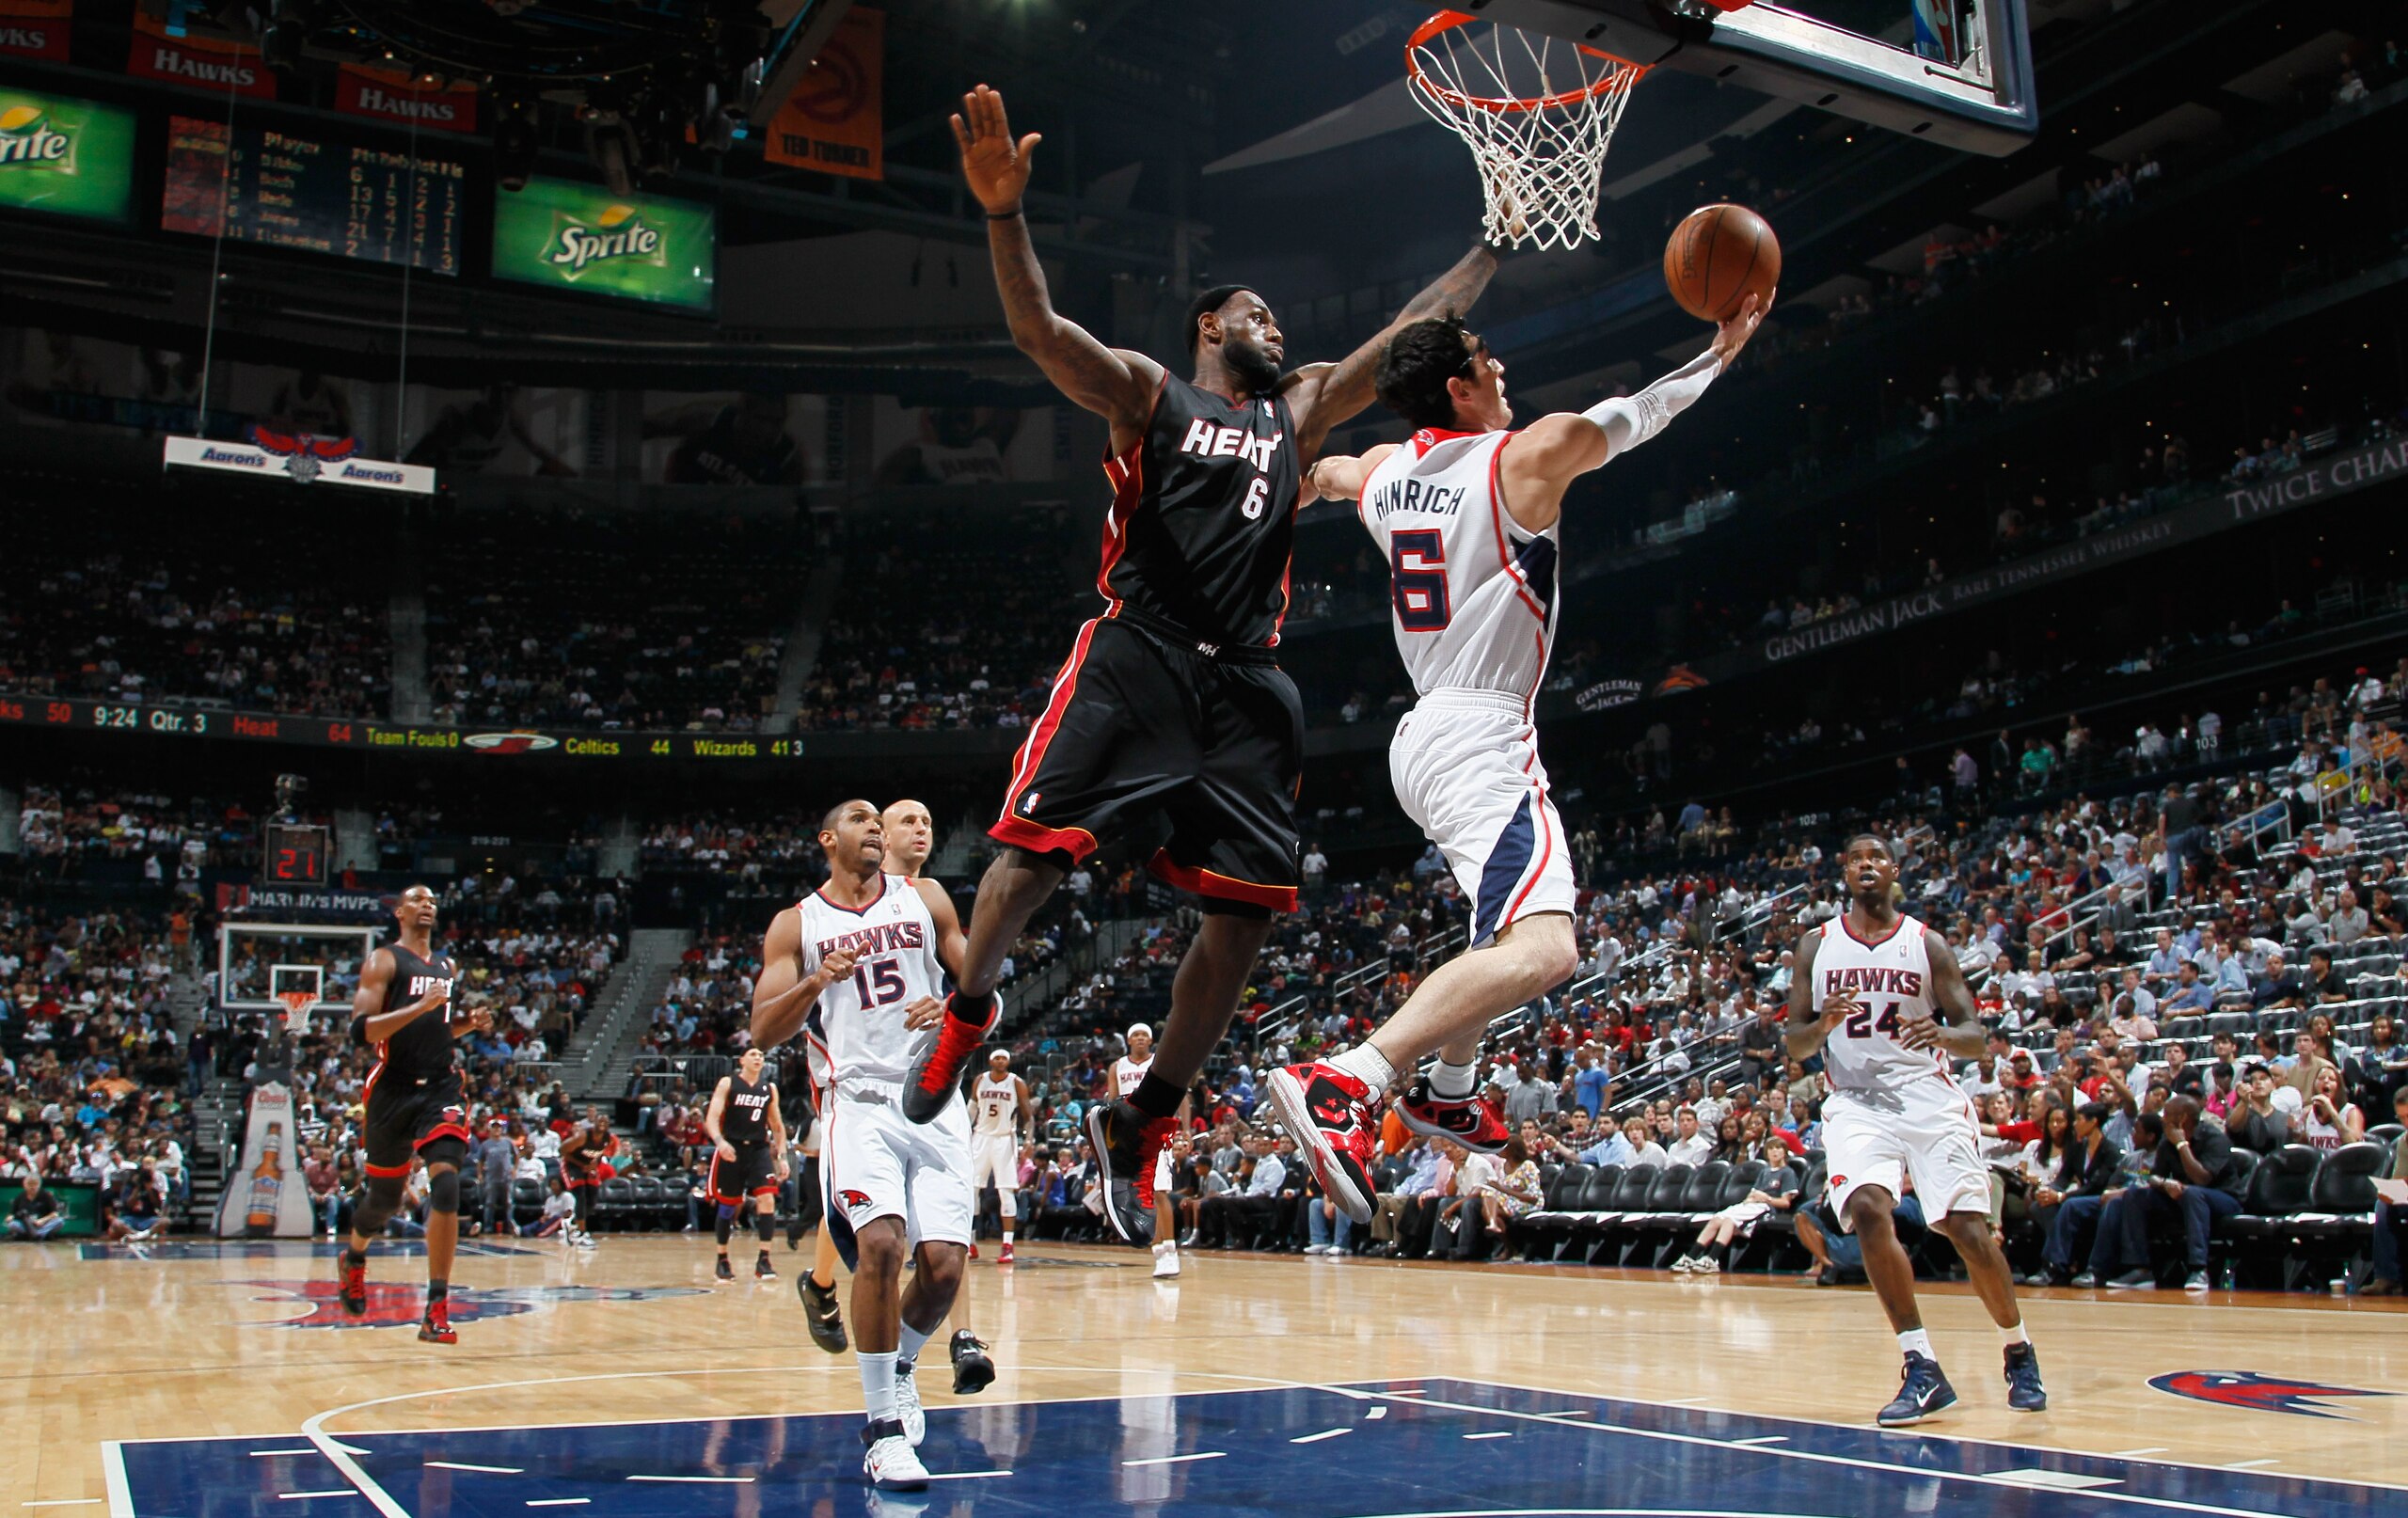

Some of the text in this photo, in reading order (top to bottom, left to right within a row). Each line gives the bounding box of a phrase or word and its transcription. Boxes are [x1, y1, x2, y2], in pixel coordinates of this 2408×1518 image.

[153, 48, 256, 87] HAWKS
[357, 86, 455, 121] HAWKS
[552, 220, 658, 270] Sprite
[1180, 418, 1284, 473] HEAT
[201, 448, 404, 483] Aaron's Aaron's
[1241, 474, 1270, 521] 6
[1374, 479, 1465, 522] HINRICH
[2226, 469, 2324, 518] TWICE
[1390, 529, 1451, 632] 6
[1765, 609, 1885, 661] GENTLEMAN
[1891, 592, 1944, 629] JACK
[1997, 548, 2088, 587] TENNESSEE
[2092, 521, 2172, 556] WHISKEY
[1576, 679, 1642, 705] GENTLEMAN
[1597, 695, 1622, 710] JACK
[47, 703, 72, 723] 50
[94, 706, 138, 728] 9:24
[150, 710, 188, 732] Qtr.
[194, 713, 208, 734] 3
[233, 715, 278, 737] Heat
[328, 723, 352, 742] 64
[366, 727, 405, 746] Team
[564, 736, 621, 755] Celtics
[650, 738, 671, 754] 44
[693, 739, 757, 756] Wizards
[2194, 735, 2218, 751] 103
[1799, 814, 1817, 827] 102
[277, 848, 315, 879] 21
[333, 894, 380, 911] MVPs
[409, 975, 453, 998] HET
[853, 957, 906, 1010] 15
[1826, 968, 1921, 997] HAWKS
[444, 1002, 452, 1023] 1
[1847, 1002, 1900, 1039] 24
[1120, 1072, 1145, 1083] HAW
[735, 1093, 770, 1109] HEAT
[981, 1091, 1011, 1101] HAWKS
[989, 1104, 998, 1116] 5
[751, 1108, 762, 1121] 0
[2310, 1136, 2341, 1148] AWKS
